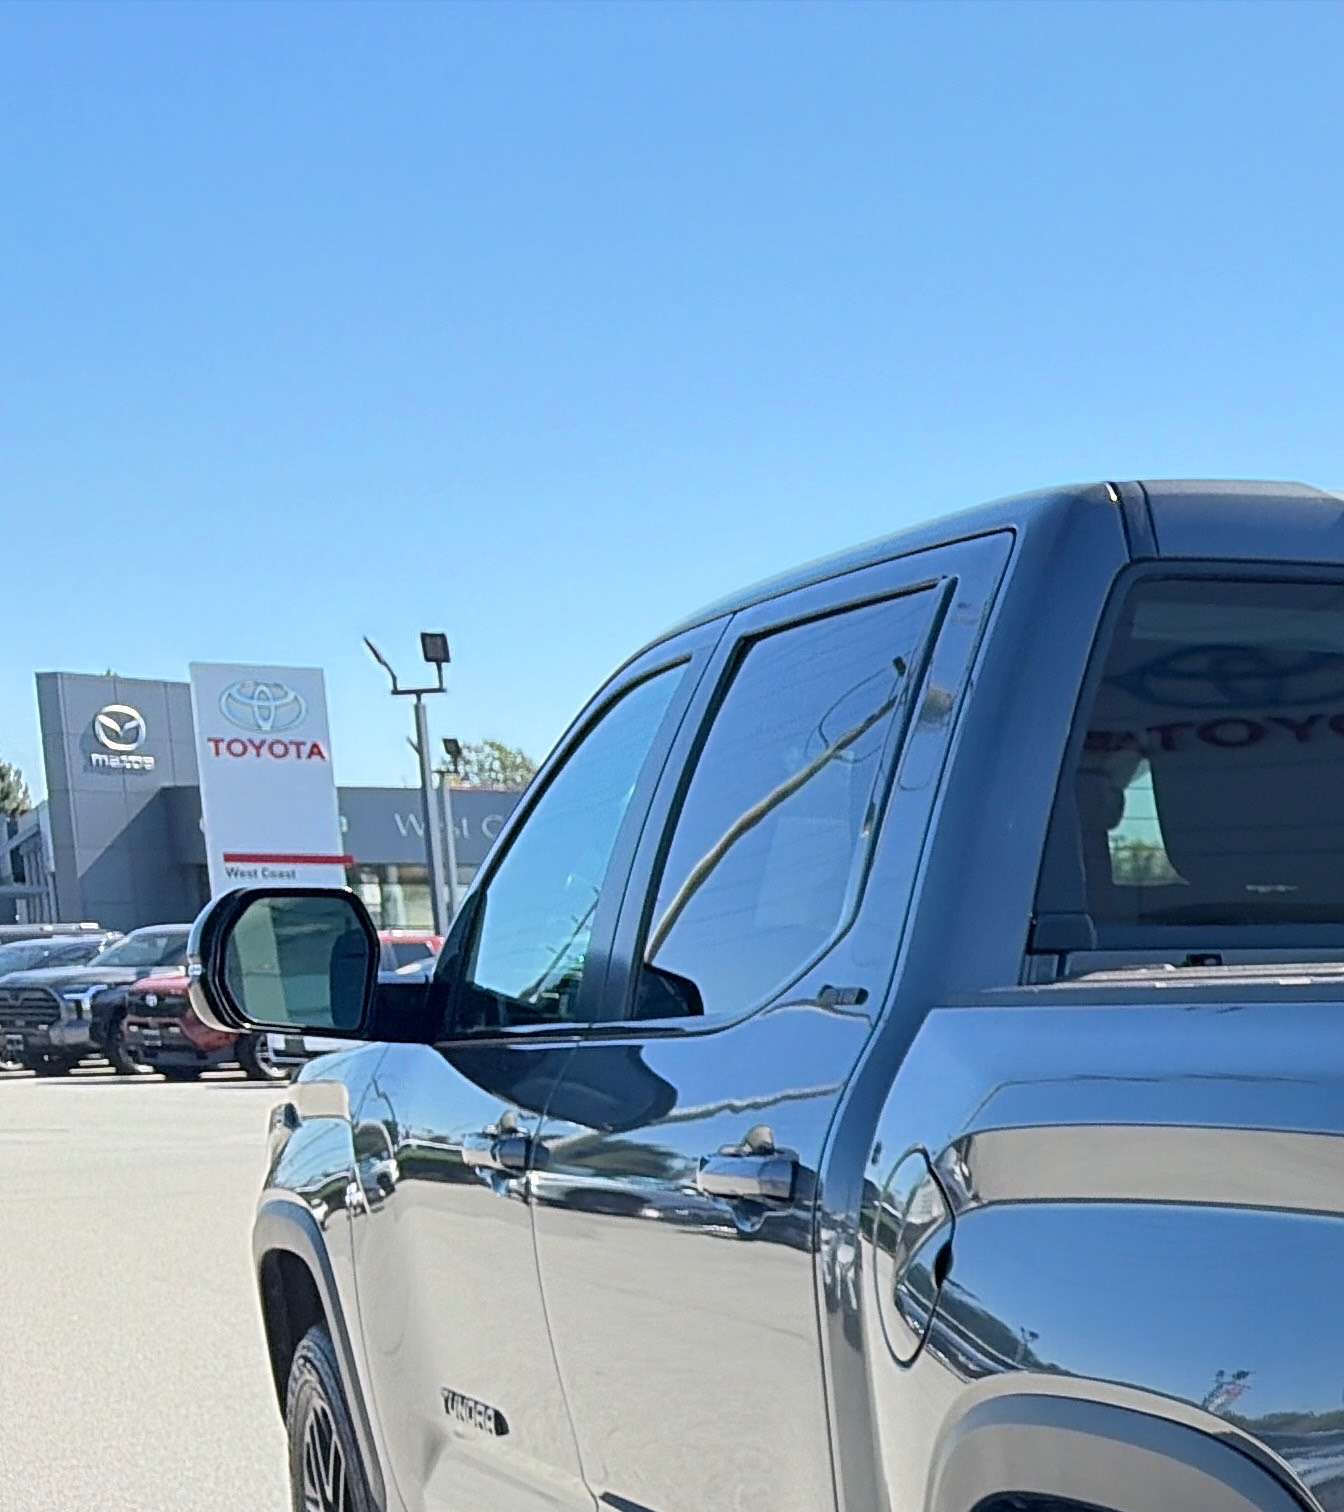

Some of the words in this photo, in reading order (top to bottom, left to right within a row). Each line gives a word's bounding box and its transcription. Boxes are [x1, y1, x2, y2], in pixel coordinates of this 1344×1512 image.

[207, 736, 327, 762] TOYOTA
[225, 866, 258, 879] West
[261, 866, 297, 880] Coast
[440, 1386, 495, 1436] TUNDRA
